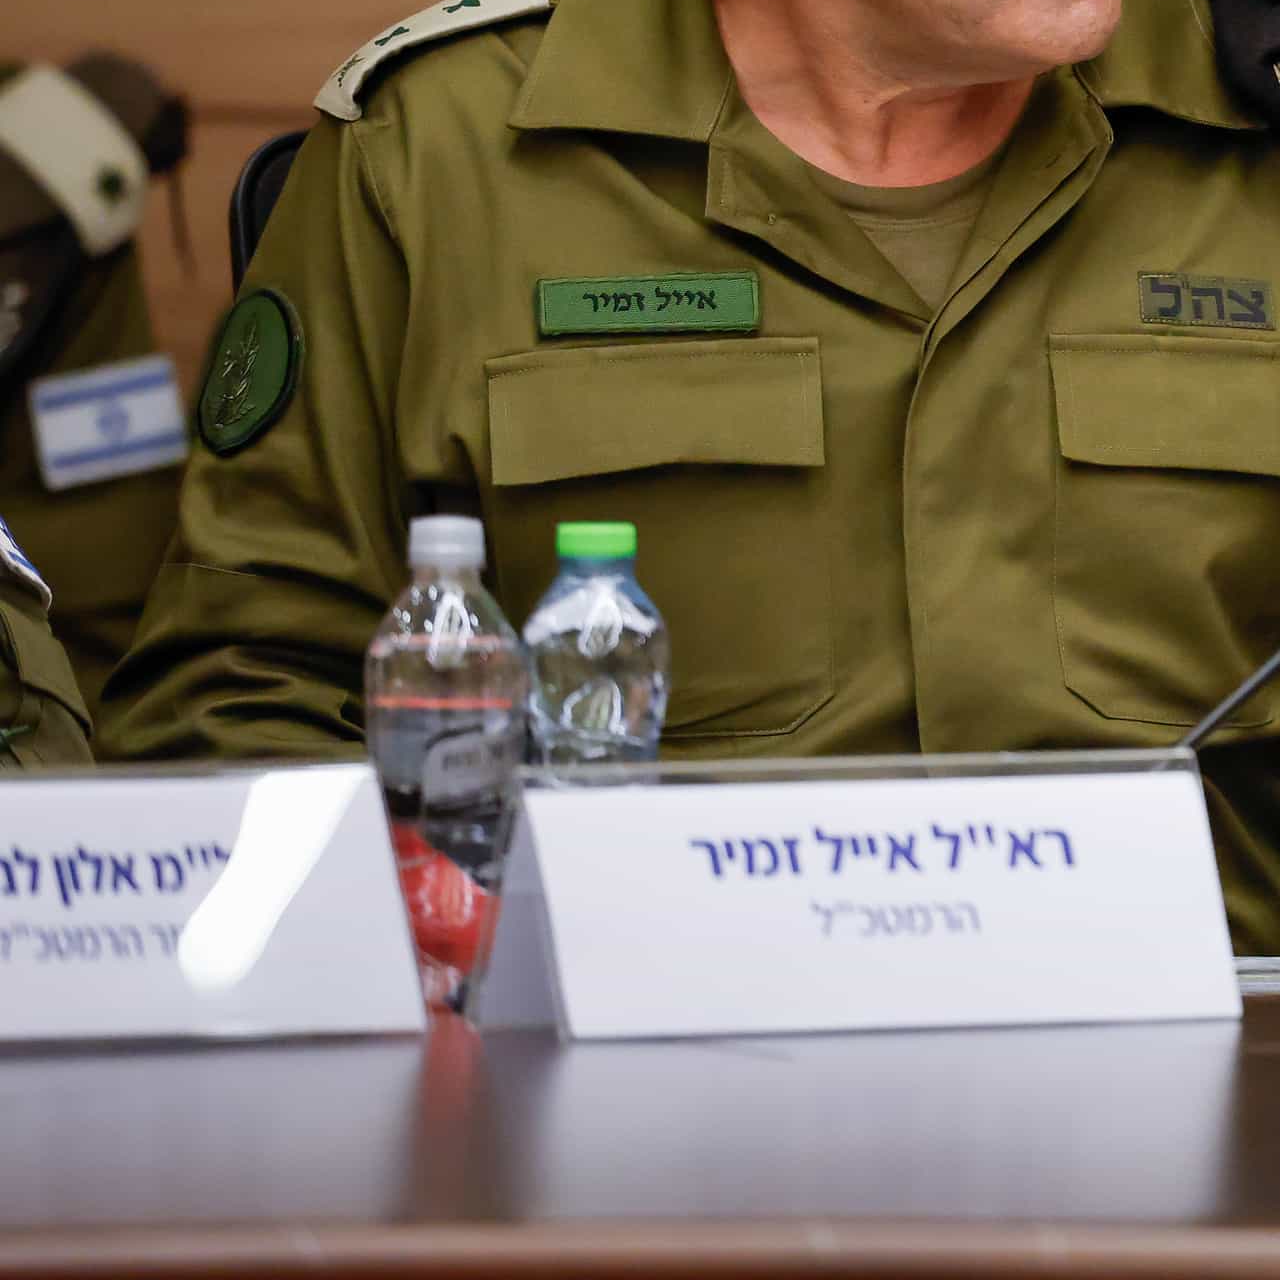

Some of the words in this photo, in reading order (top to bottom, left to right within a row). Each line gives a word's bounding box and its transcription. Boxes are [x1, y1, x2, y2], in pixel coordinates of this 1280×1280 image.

[582, 291, 645, 313] זמיר
[655, 286, 718, 312] אייל
[689, 834, 802, 880] זמיר
[813, 825, 923, 874] אייל
[52, 845, 141, 908] אלון
